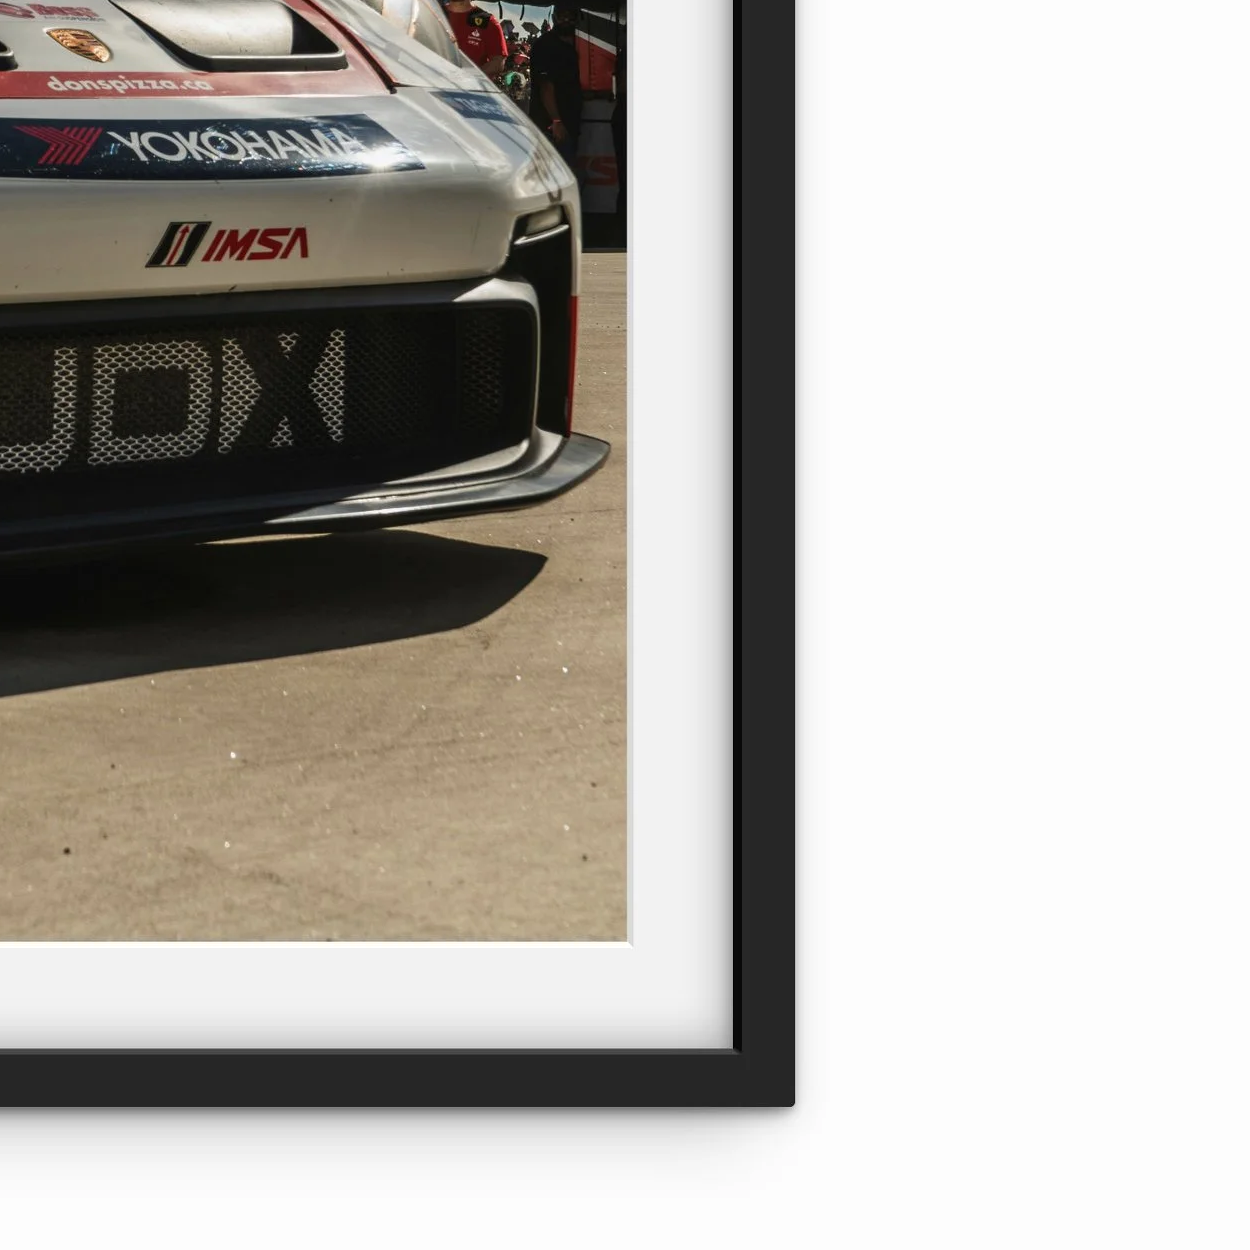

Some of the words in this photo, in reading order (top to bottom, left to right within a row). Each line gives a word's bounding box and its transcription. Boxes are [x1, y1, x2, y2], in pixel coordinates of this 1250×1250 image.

[47, 75, 214, 94] donspizza.ca
[107, 126, 368, 162] YOKOHAMA
[200, 226, 309, 262] IMSA
